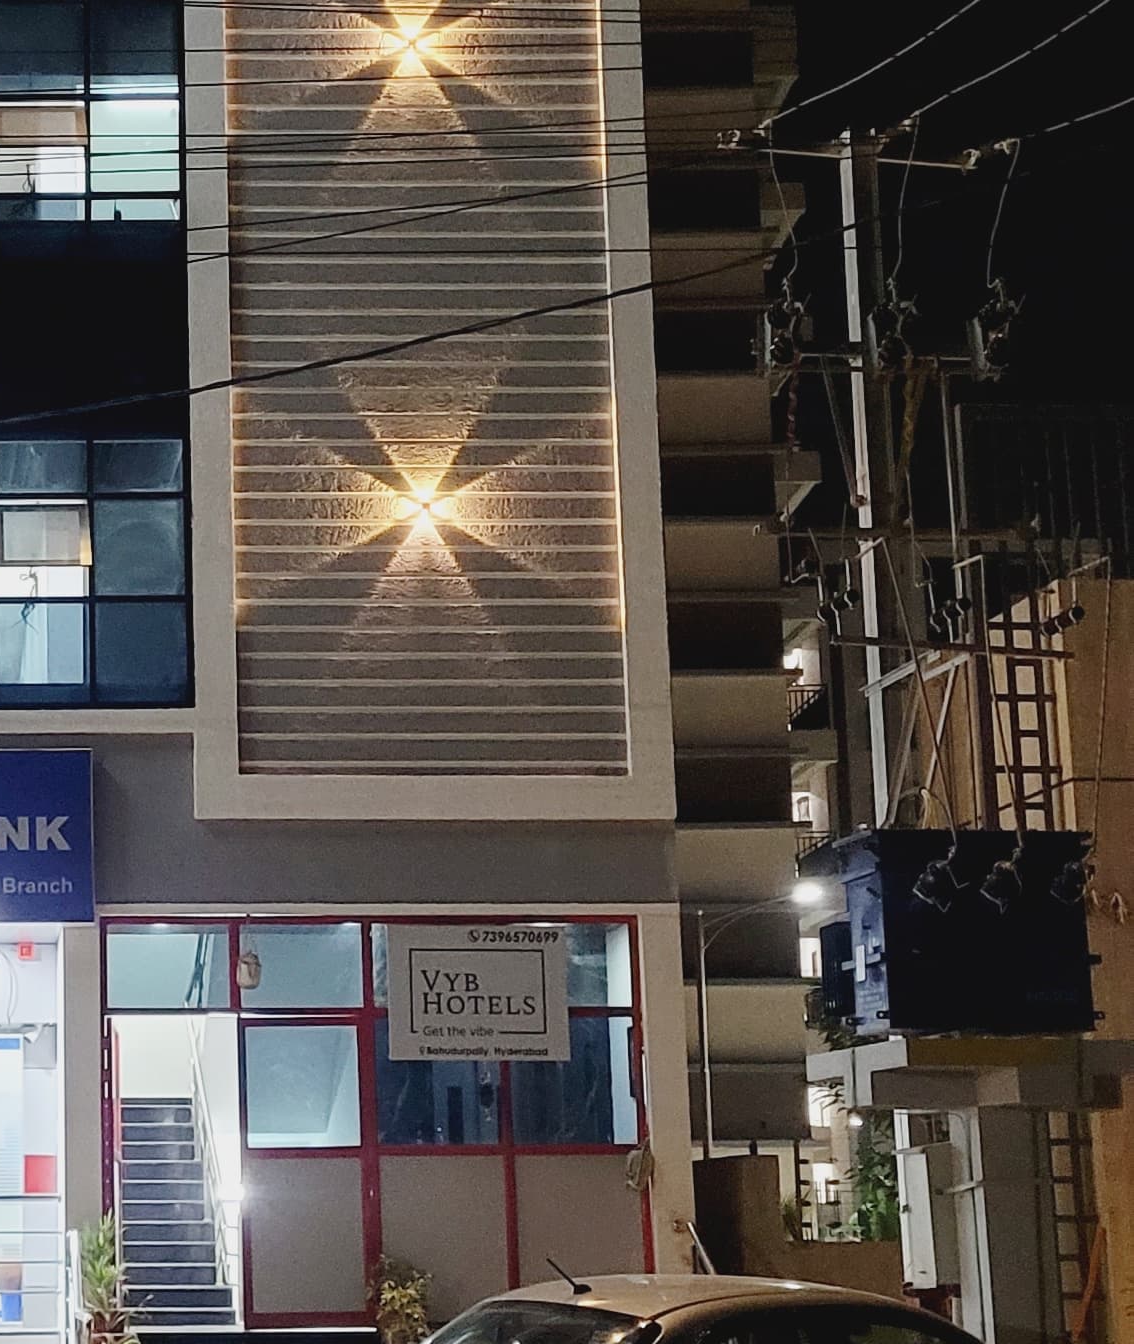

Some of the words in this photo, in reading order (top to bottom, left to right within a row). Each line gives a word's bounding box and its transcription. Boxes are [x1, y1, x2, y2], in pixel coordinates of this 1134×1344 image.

[3, 877, 73, 894] Branch
[482, 930, 559, 944] 7396570699
[421, 969, 480, 992] VYB
[422, 992, 537, 1015] HOTELS
[423, 1025, 444, 1037] Get
[447, 1026, 466, 1037] the
[470, 1026, 495, 1037] vibe
